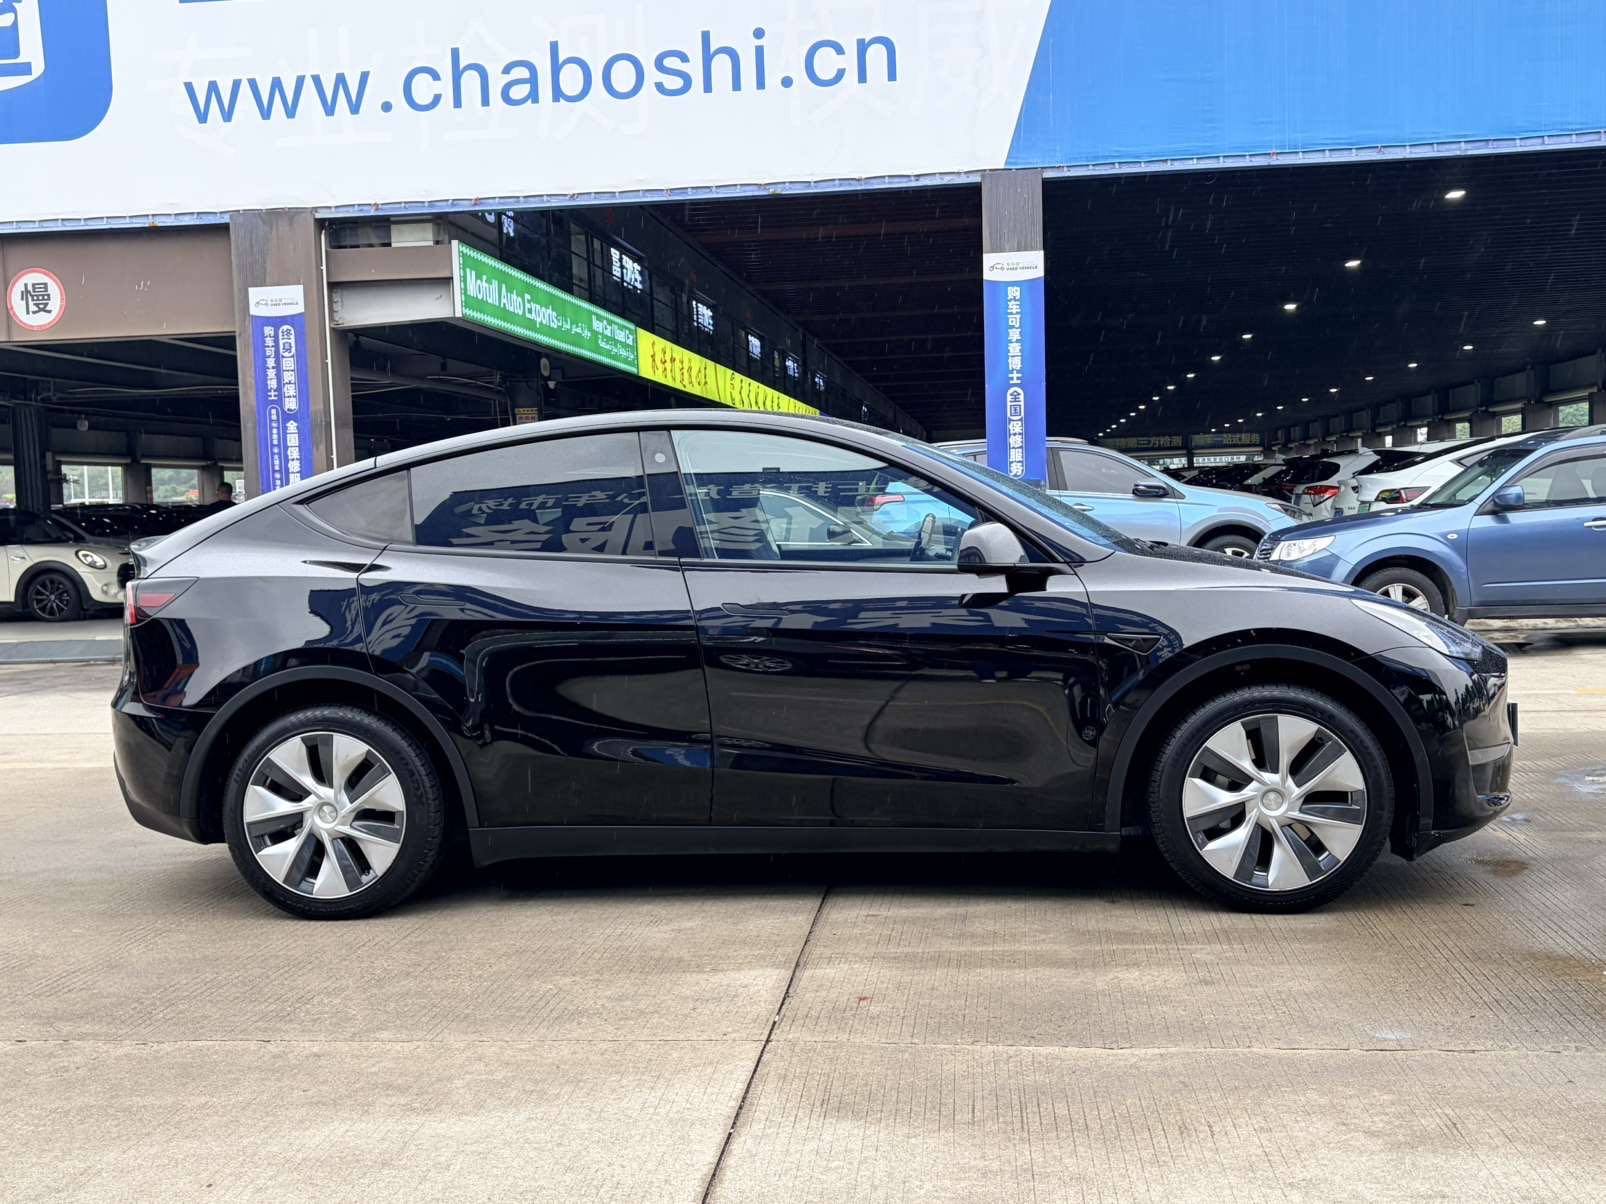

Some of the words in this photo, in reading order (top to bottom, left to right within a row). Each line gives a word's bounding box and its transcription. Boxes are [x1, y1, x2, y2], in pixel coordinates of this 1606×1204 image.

[184, 28, 896, 123] www.chaboshi.cn
[20, 282, 52, 315] 慢
[466, 267, 498, 306] Mofull
[501, 284, 523, 315] Auto
[525, 293, 557, 329] Exports
[1007, 287, 1022, 384] 购车可享查博士
[263, 326, 278, 400] 购车可享查博士
[281, 328, 297, 411] 终身回购保障
[1008, 390, 1024, 476] 全国保修服务
